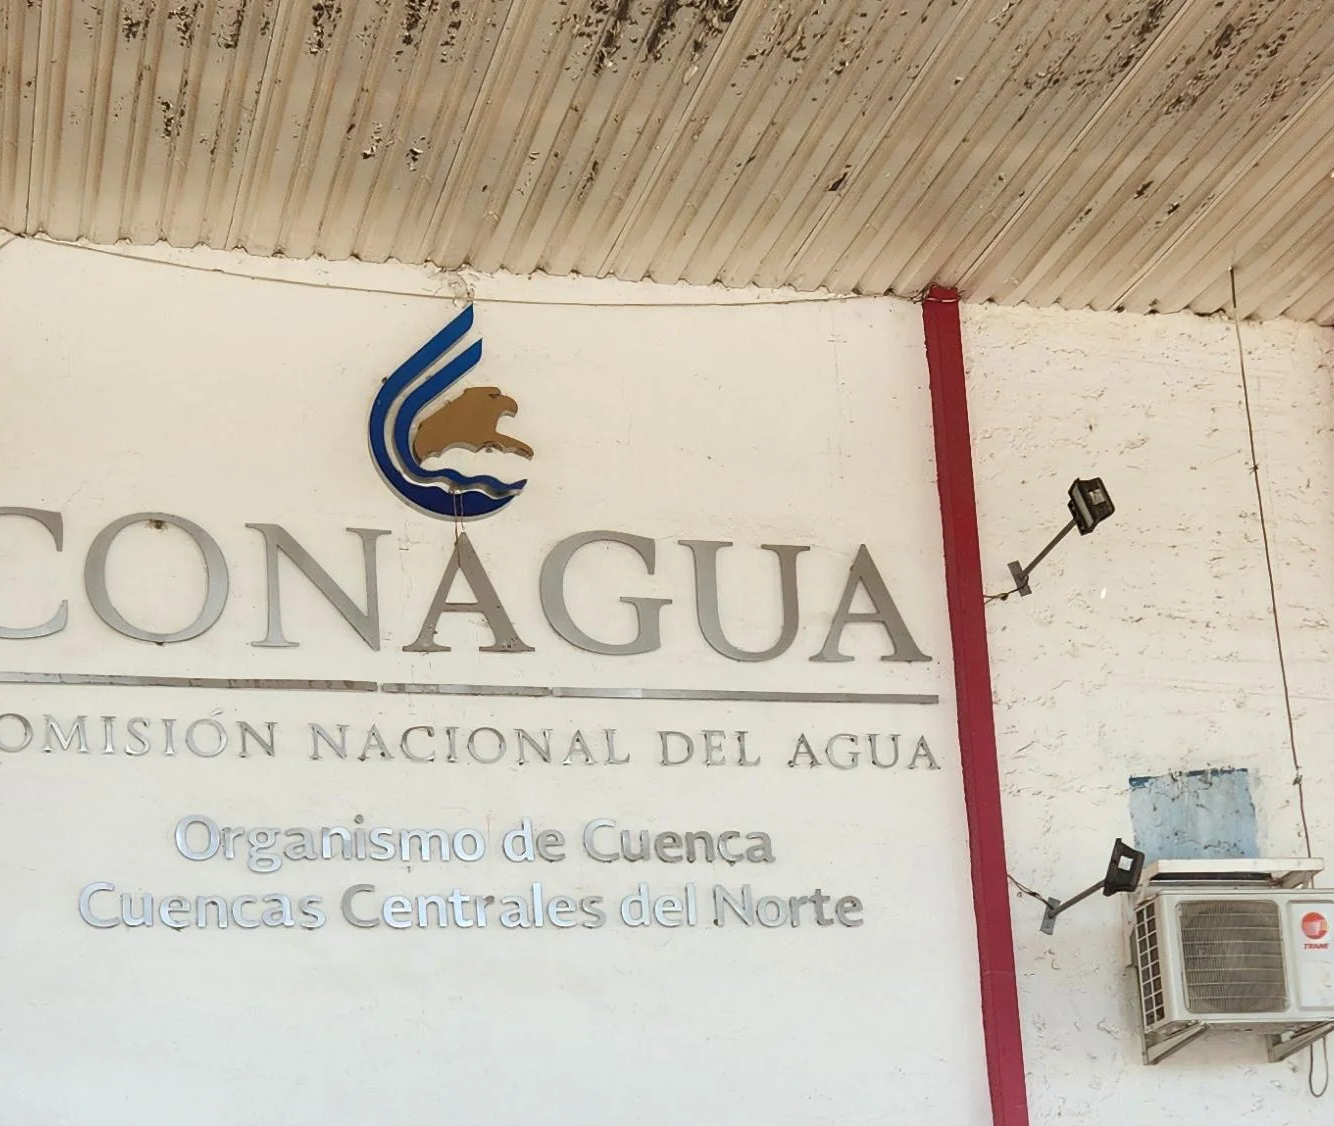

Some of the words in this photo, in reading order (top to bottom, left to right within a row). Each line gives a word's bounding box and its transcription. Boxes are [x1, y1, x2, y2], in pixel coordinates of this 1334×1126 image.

[309, 724, 630, 766] NACIONAL
[660, 729, 761, 768] DEL
[787, 732, 941, 771] AGUA
[174, 814, 485, 873] Organismo
[502, 818, 565, 863] de
[582, 818, 776, 864] Cuenca
[78, 881, 327, 930] Cuencas
[341, 882, 607, 929] Centrales
[620, 882, 696, 928] del
[713, 884, 865, 928] Norte
